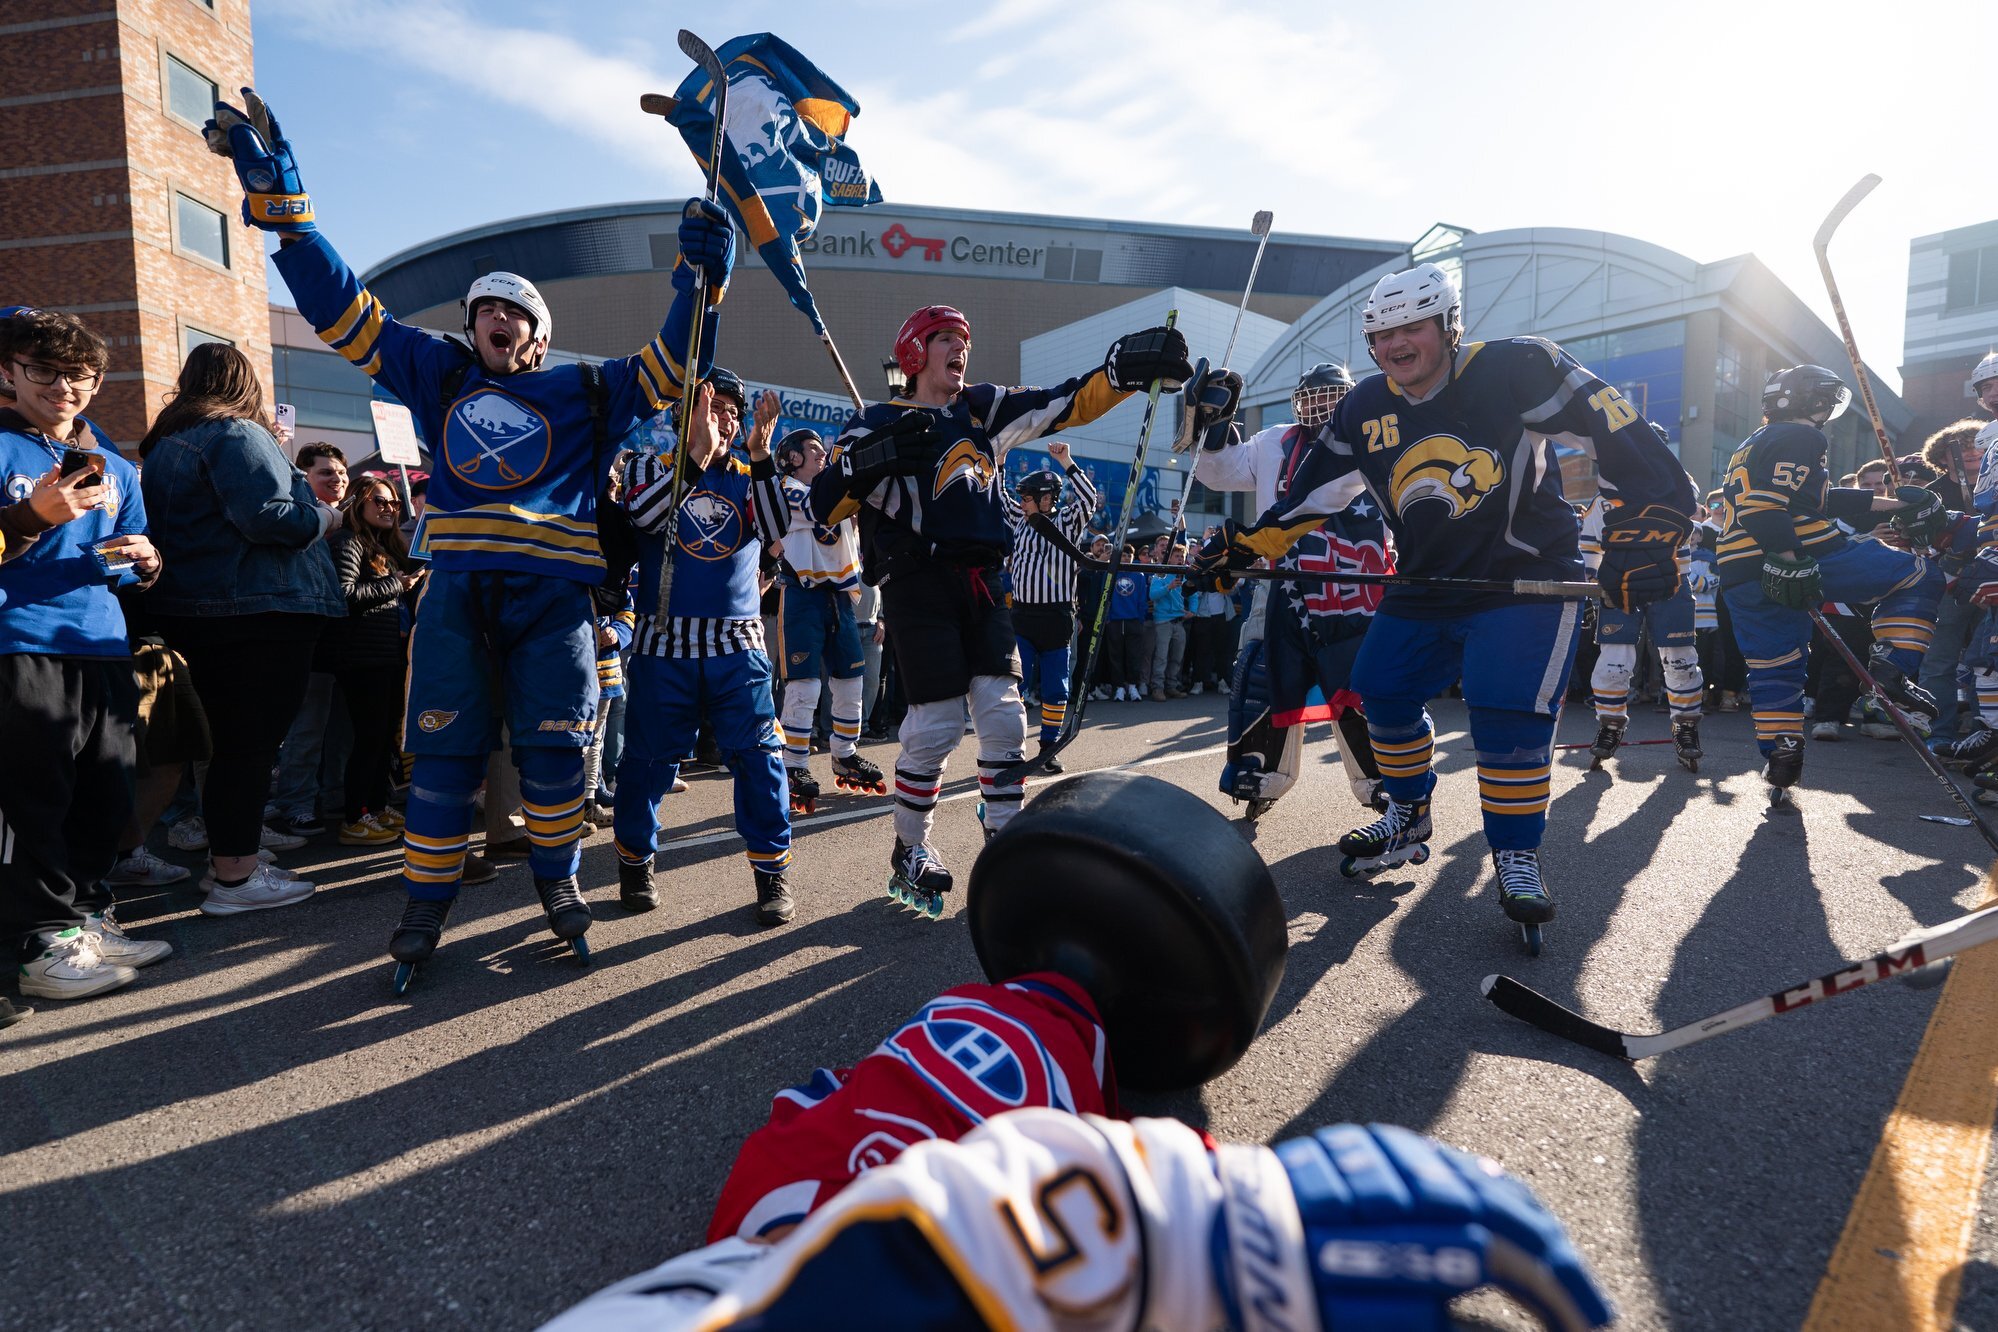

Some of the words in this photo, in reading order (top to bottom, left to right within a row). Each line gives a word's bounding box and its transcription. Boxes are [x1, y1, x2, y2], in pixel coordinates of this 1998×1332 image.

[949, 234, 1044, 267] Center
[491, 278, 516, 287] CCM
[1380, 302, 1406, 315] CCM
[751, 388, 854, 424] tketmas
[1361, 413, 1401, 454] 26
[1876, 428, 1901, 483] EASTON
[1771, 461, 1811, 491] 53
[669, 508, 679, 546] CCM
[1607, 529, 1678, 543] CM
[1763, 563, 1820, 579] BAUER
[1769, 943, 1928, 1014] CCM
